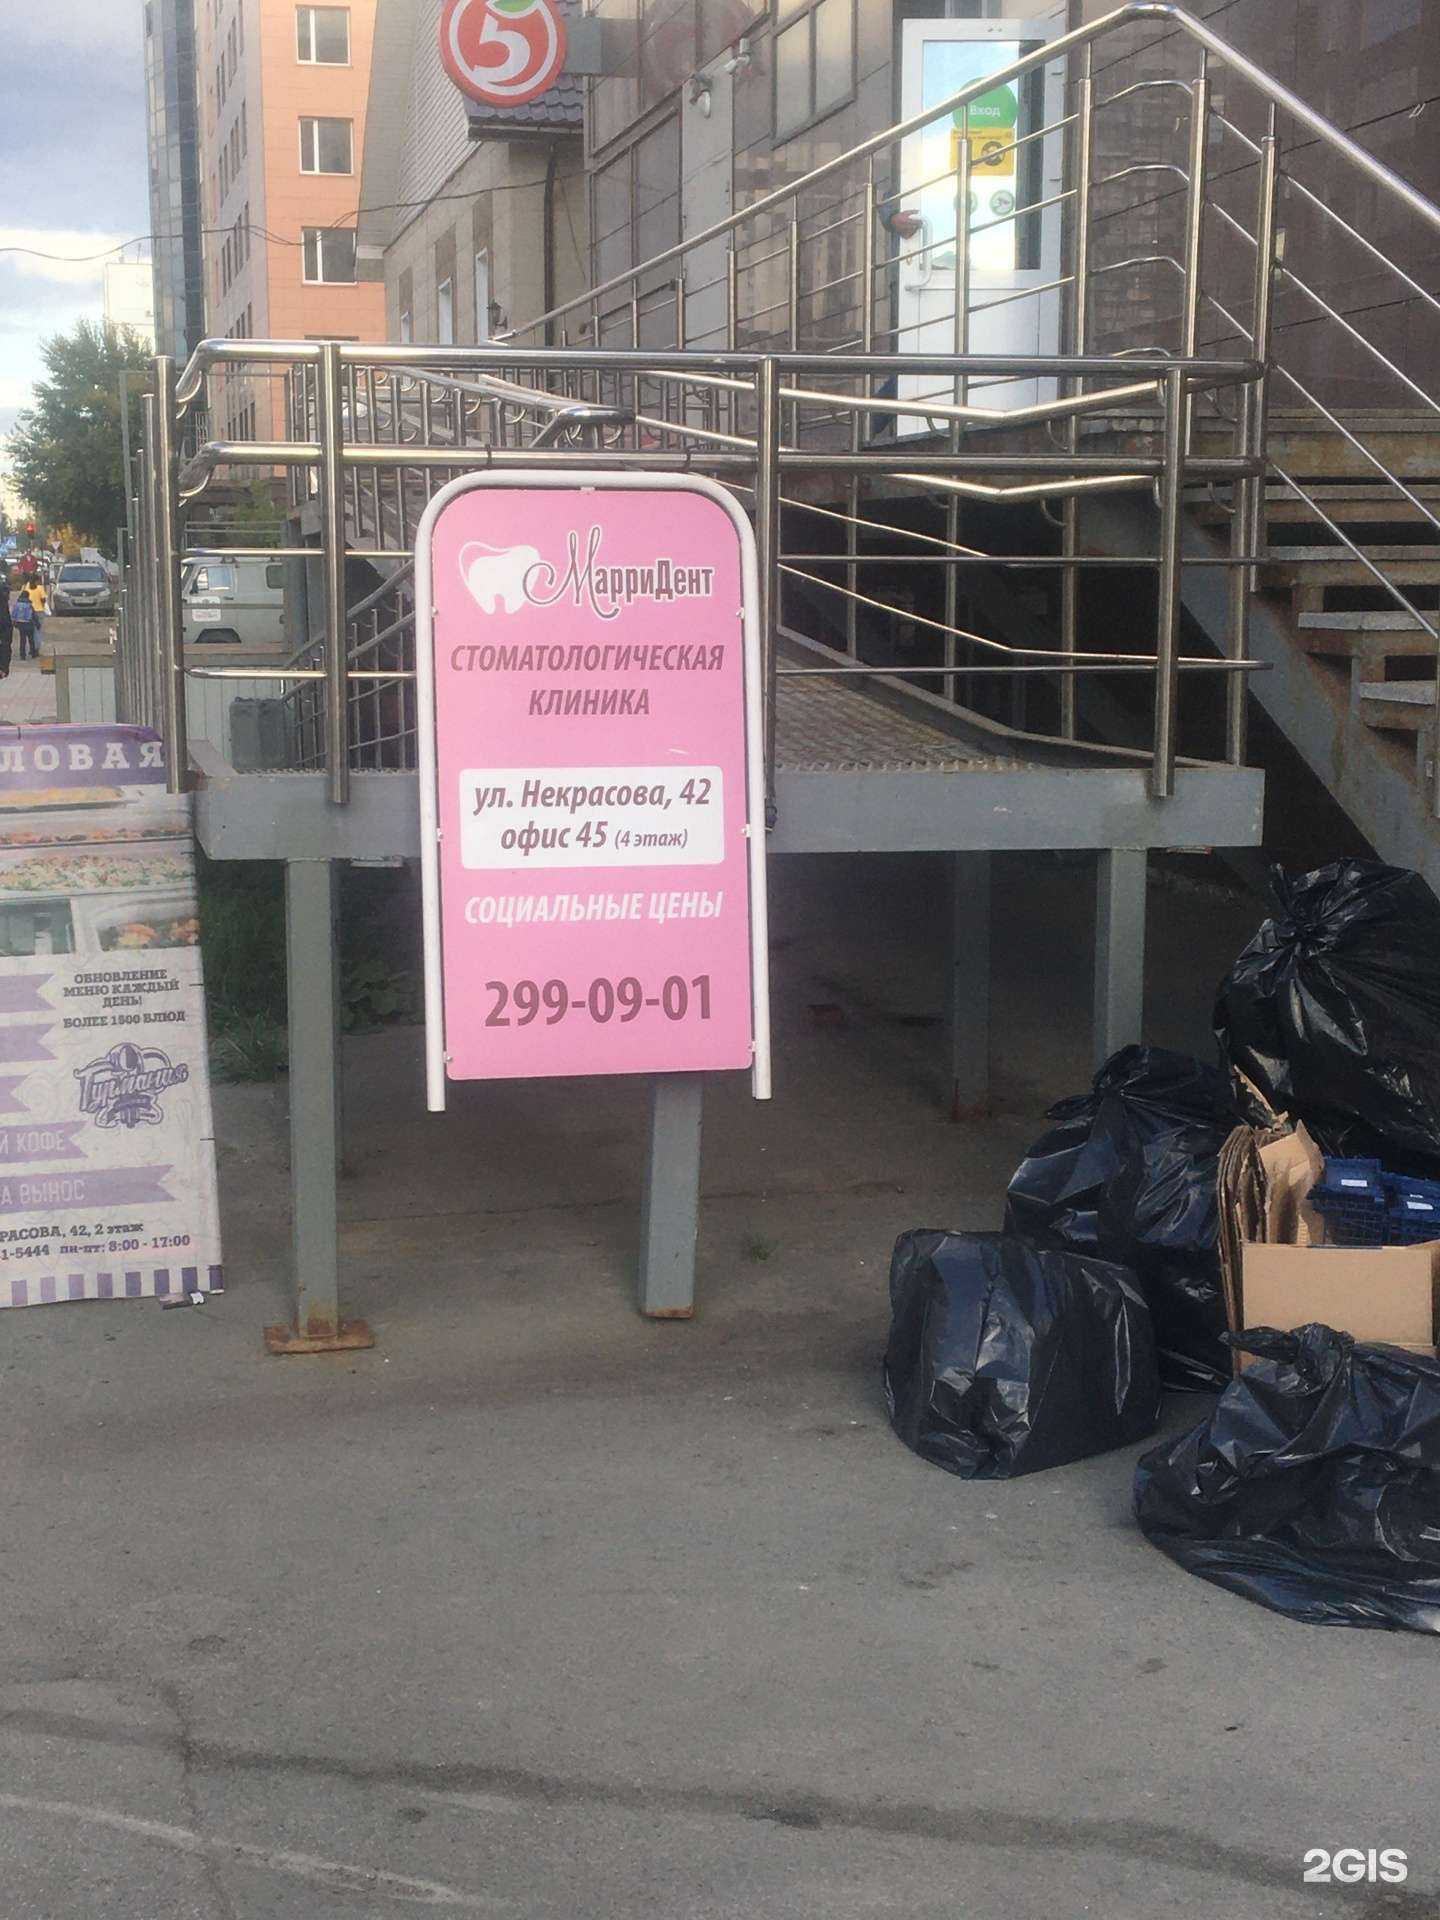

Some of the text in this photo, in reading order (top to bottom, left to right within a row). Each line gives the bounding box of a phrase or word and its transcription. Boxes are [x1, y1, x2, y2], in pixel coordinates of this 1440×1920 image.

[968, 104, 1001, 119] Вход
[523, 525, 714, 621] МарриДент
[451, 644, 725, 673] СТОМАТОЛОГИЧЕСКАЯ
[528, 688, 651, 716] КЛИНИКА
[0, 741, 165, 773] ЛОВАЯ
[473, 777, 712, 816] ул. Некрасова, 42
[500, 820, 689, 857] офис 45 (4 этаж)
[464, 890, 724, 929] СОЦИАЛЬНЫЕ ЦЕНЫ
[63, 978, 180, 998] МЕНЮ КАЖДЫЙ
[73, 968, 169, 984] ОБНОВЛЕНИЕ
[102, 995, 143, 1009] ДЕНЬ!
[484, 974, 712, 1028] 299-09-01
[63, 1016, 109, 1029] БОЛЕЕ
[143, 1010, 186, 1025] БЛЮД
[16, 1130, 65, 1154] КОФЕ
[20, 1180, 86, 1205] ВЫНОС
[0, 1223, 145, 1243] РАСОВА, 42, 2 этаж
[108, 1238, 140, 1252] 8:00
[151, 1234, 191, 1249] 17:00
